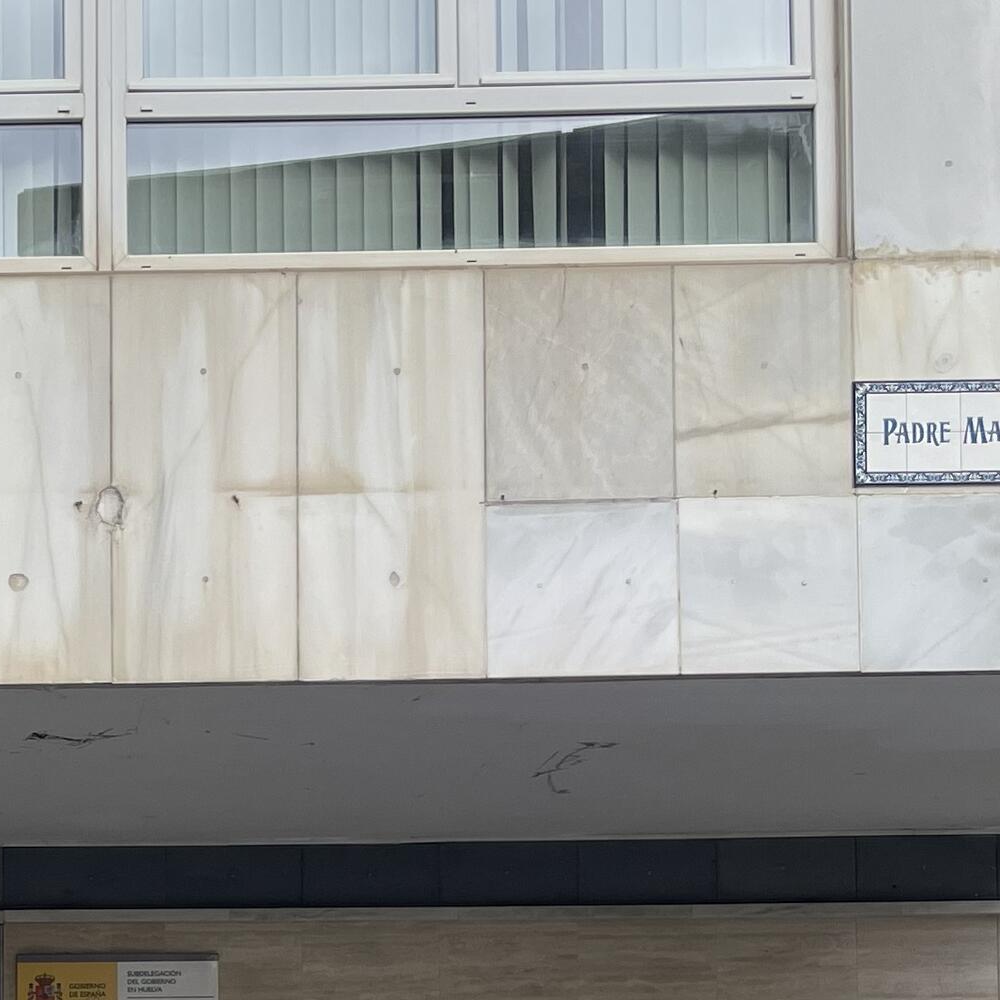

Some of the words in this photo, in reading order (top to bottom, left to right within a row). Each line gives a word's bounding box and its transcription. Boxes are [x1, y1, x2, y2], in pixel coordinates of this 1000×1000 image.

[882, 417, 952, 447] PADRE
[68, 982, 106, 990] GOBIERNO
[69, 990, 78, 998] DE
[80, 990, 106, 998] ESPAÑA
